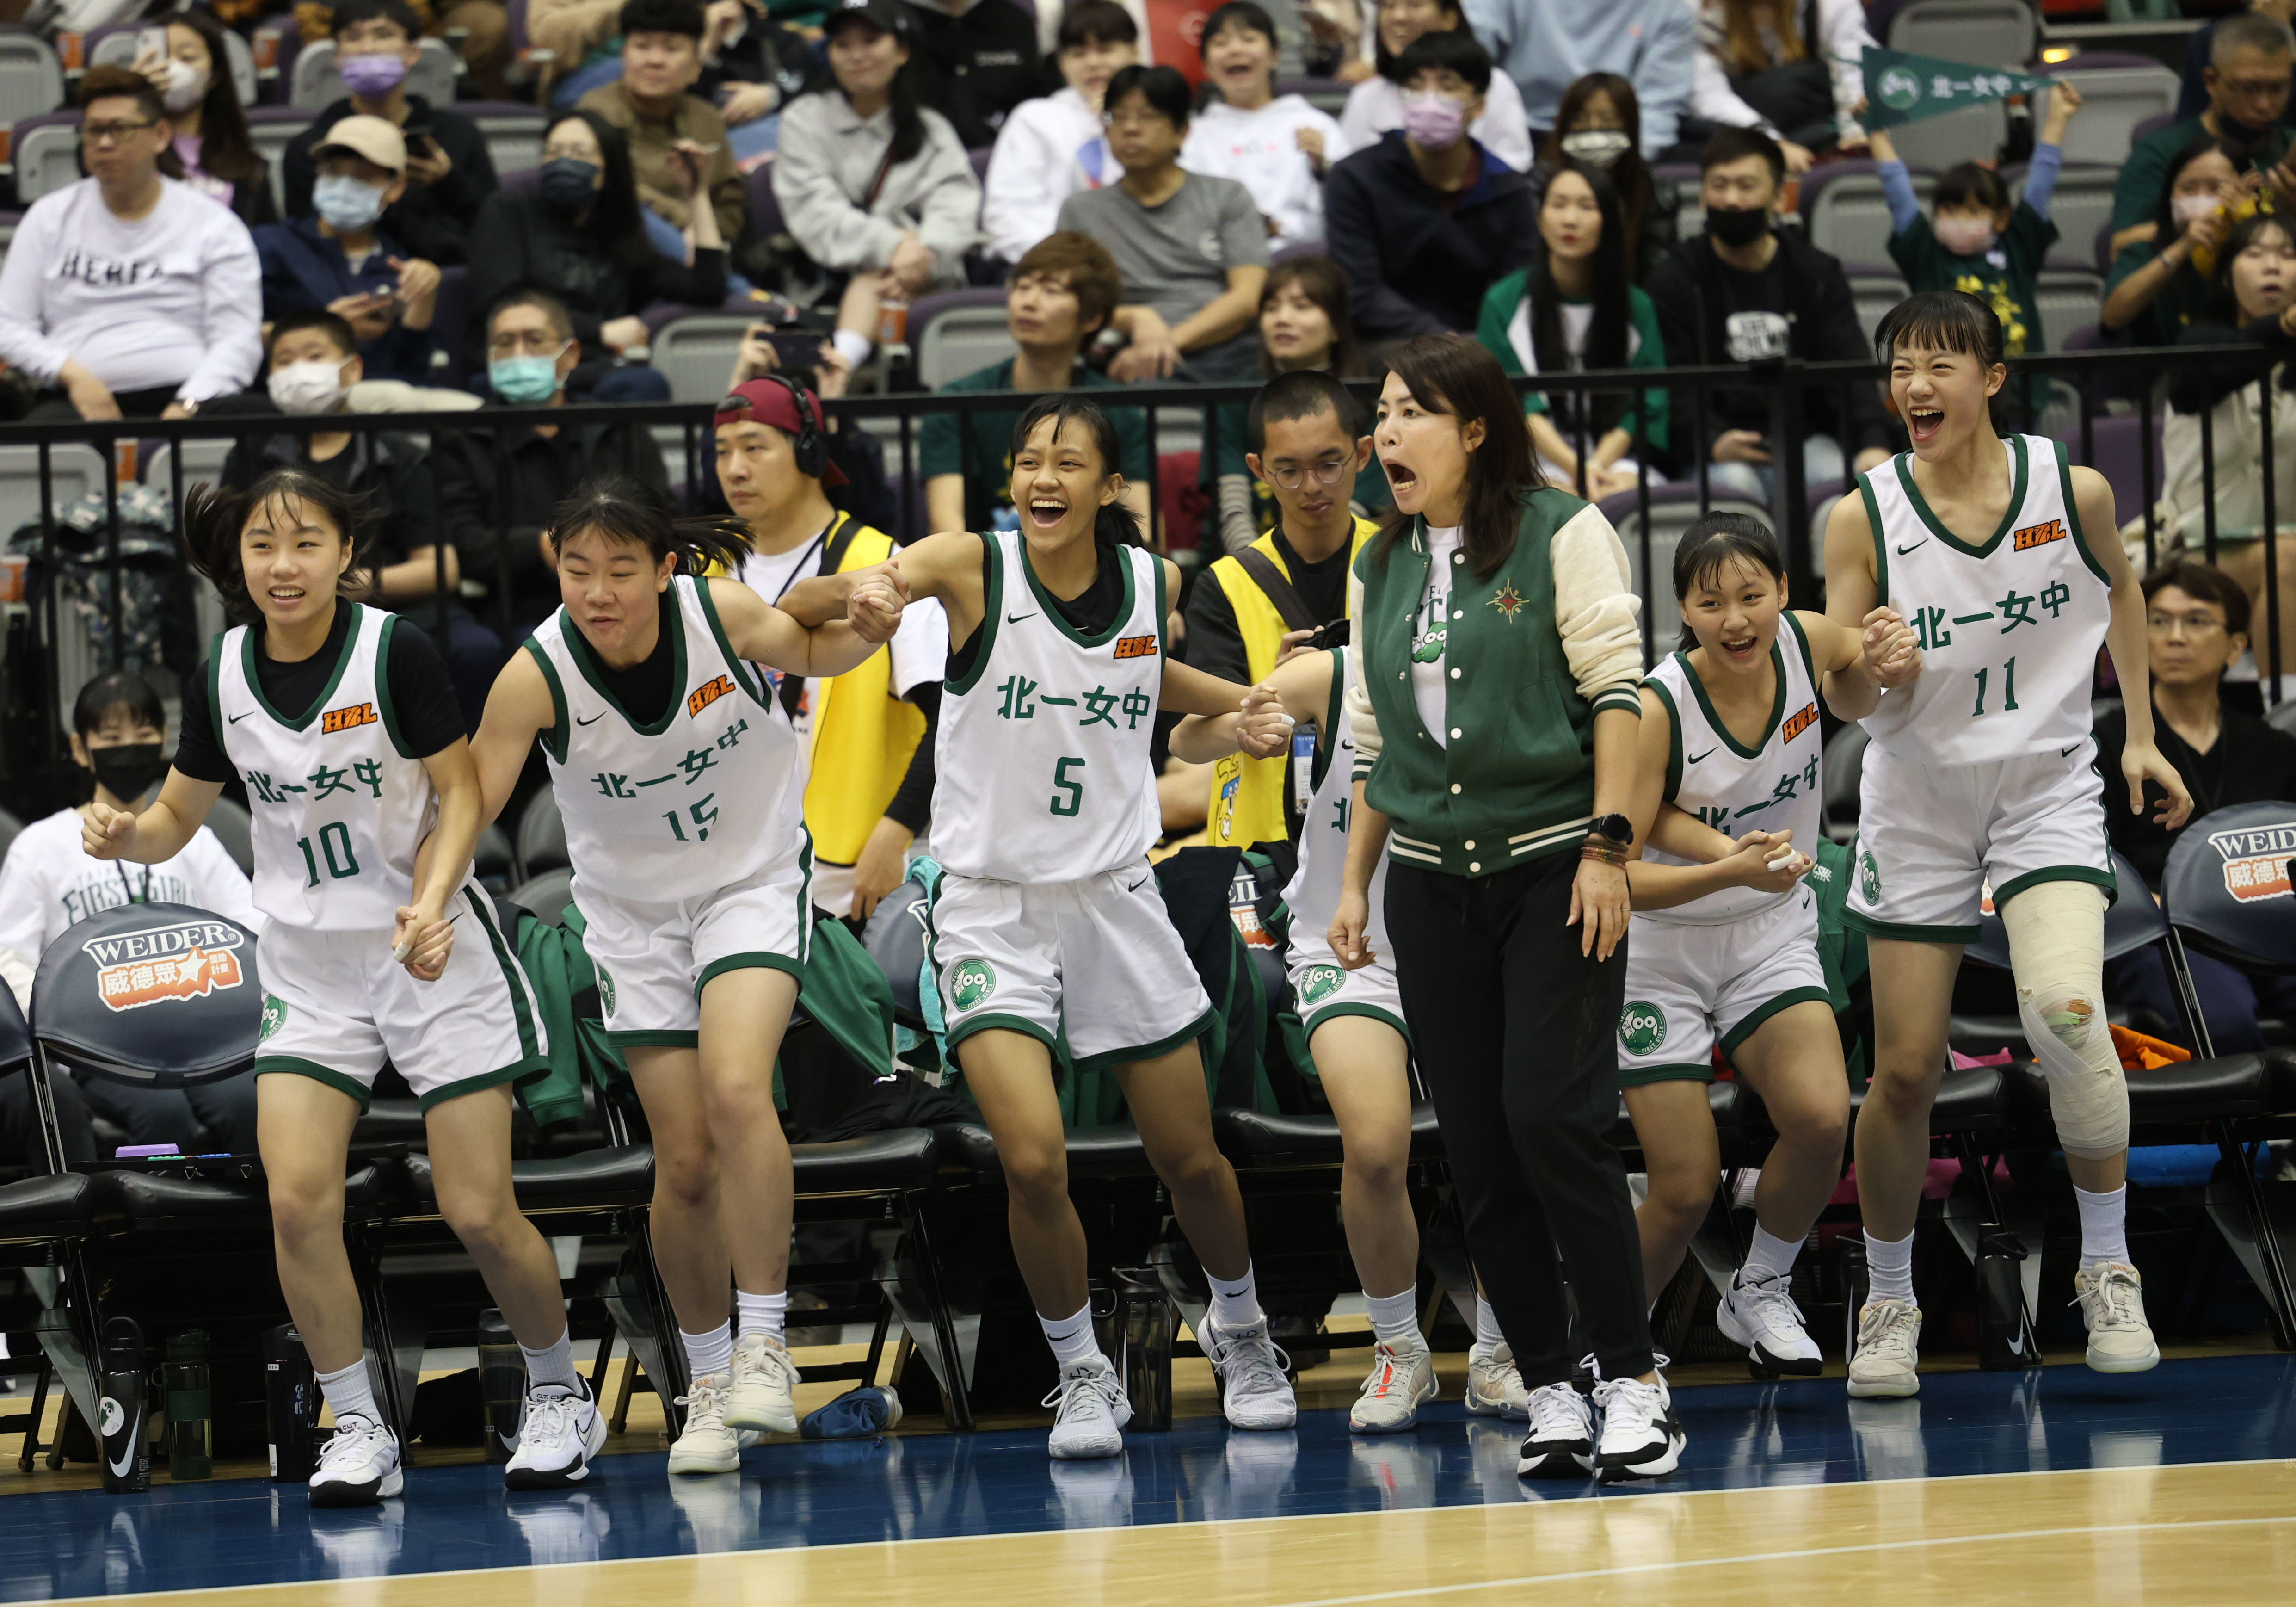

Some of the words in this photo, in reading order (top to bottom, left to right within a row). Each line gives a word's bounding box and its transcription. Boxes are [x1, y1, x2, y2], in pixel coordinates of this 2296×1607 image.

[2013, 519, 2066, 552] HBL
[1910, 580, 2070, 651] 北一女中
[1113, 635, 1158, 659] HBL
[687, 674, 736, 720] HBL
[997, 675, 1151, 730] 北一女中
[1971, 656, 2019, 717] 11
[322, 702, 378, 736] HBL
[1782, 701, 1819, 746] HBL
[590, 718, 749, 798] 北一女中
[247, 758, 383, 803] 北一女中
[1050, 756, 1086, 817] 5
[661, 792, 719, 841] 15
[297, 822, 360, 889] 10
[2216, 829, 2296, 857] WEID
[104, 961, 179, 997] 威德眾
[953, 964, 965, 982] TAIPEI
[1319, 989, 1333, 1000] FIRST
[1333, 976, 1343, 989] GIRLS
[967, 997, 982, 1009] FIRST
[983, 983, 993, 999] GIRLS
[1642, 1042, 1656, 1054] FIRST
[1656, 1026, 1664, 1043] GIRLS
[343, 1422, 358, 1430] CUT
